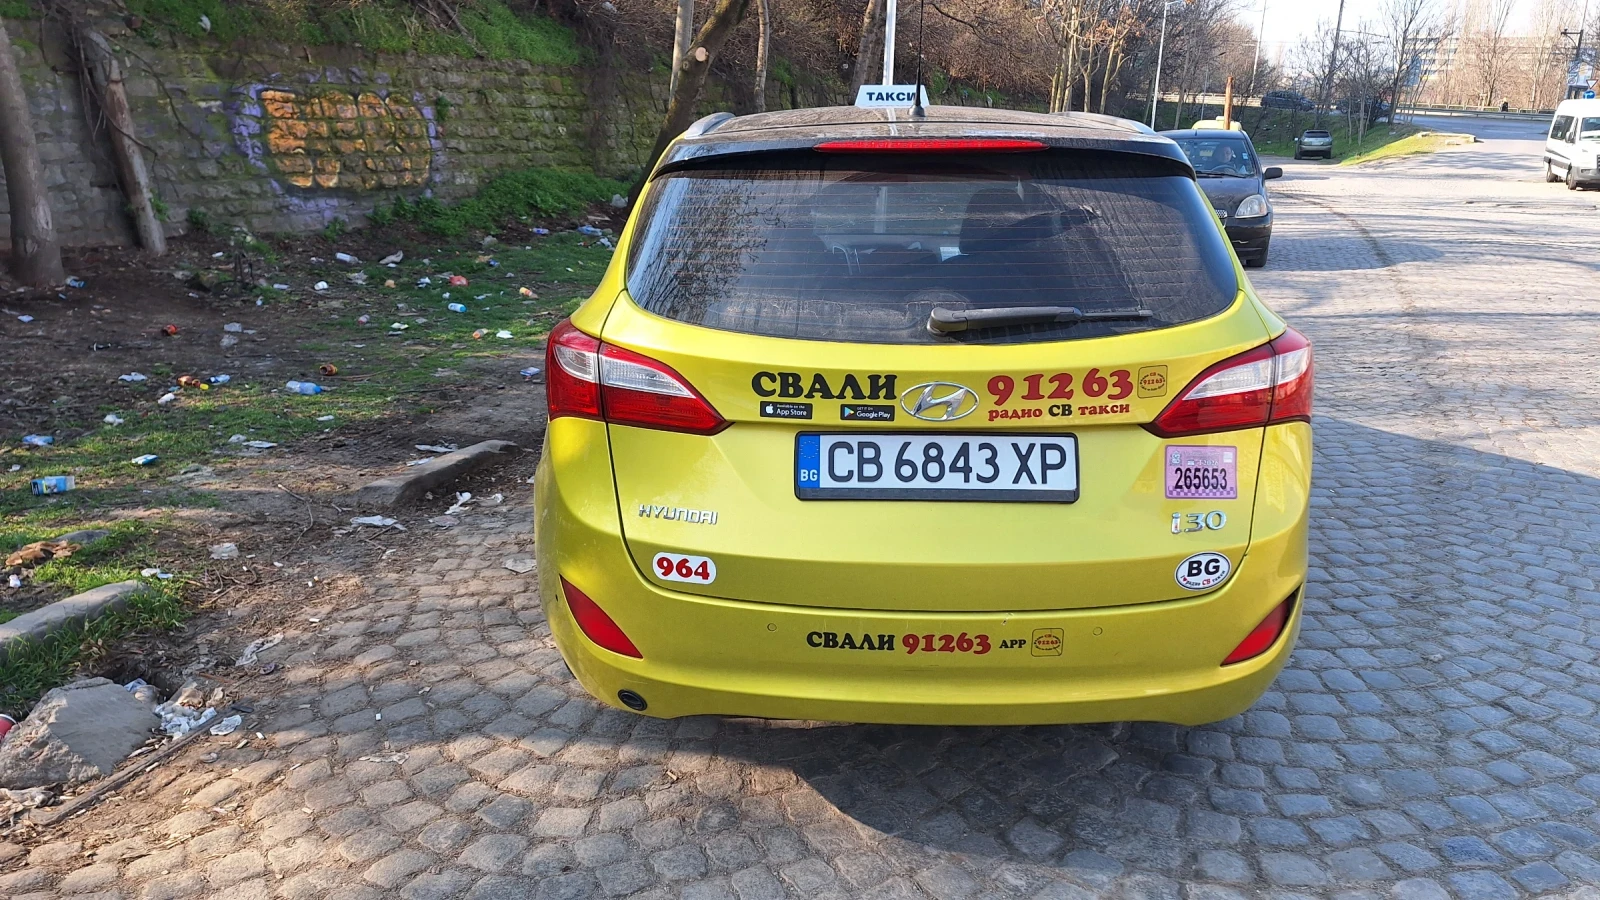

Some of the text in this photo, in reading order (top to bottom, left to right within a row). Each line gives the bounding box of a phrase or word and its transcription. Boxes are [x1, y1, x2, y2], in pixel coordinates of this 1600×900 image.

[751, 371, 898, 400] СВАЛИ
[776, 408, 790, 416] App
[856, 411, 891, 419] Google Play
[988, 404, 1130, 421] радио СВ такси
[828, 441, 1067, 485] CB 6843 XP
[800, 469, 818, 481] BG
[1174, 467, 1228, 490] 265653
[638, 503, 719, 525] HYUNDAI
[656, 556, 710, 580] 964
[1187, 558, 1221, 577] BG
[806, 631, 895, 651] СВАЛИ
[902, 632, 992, 654] 91263
